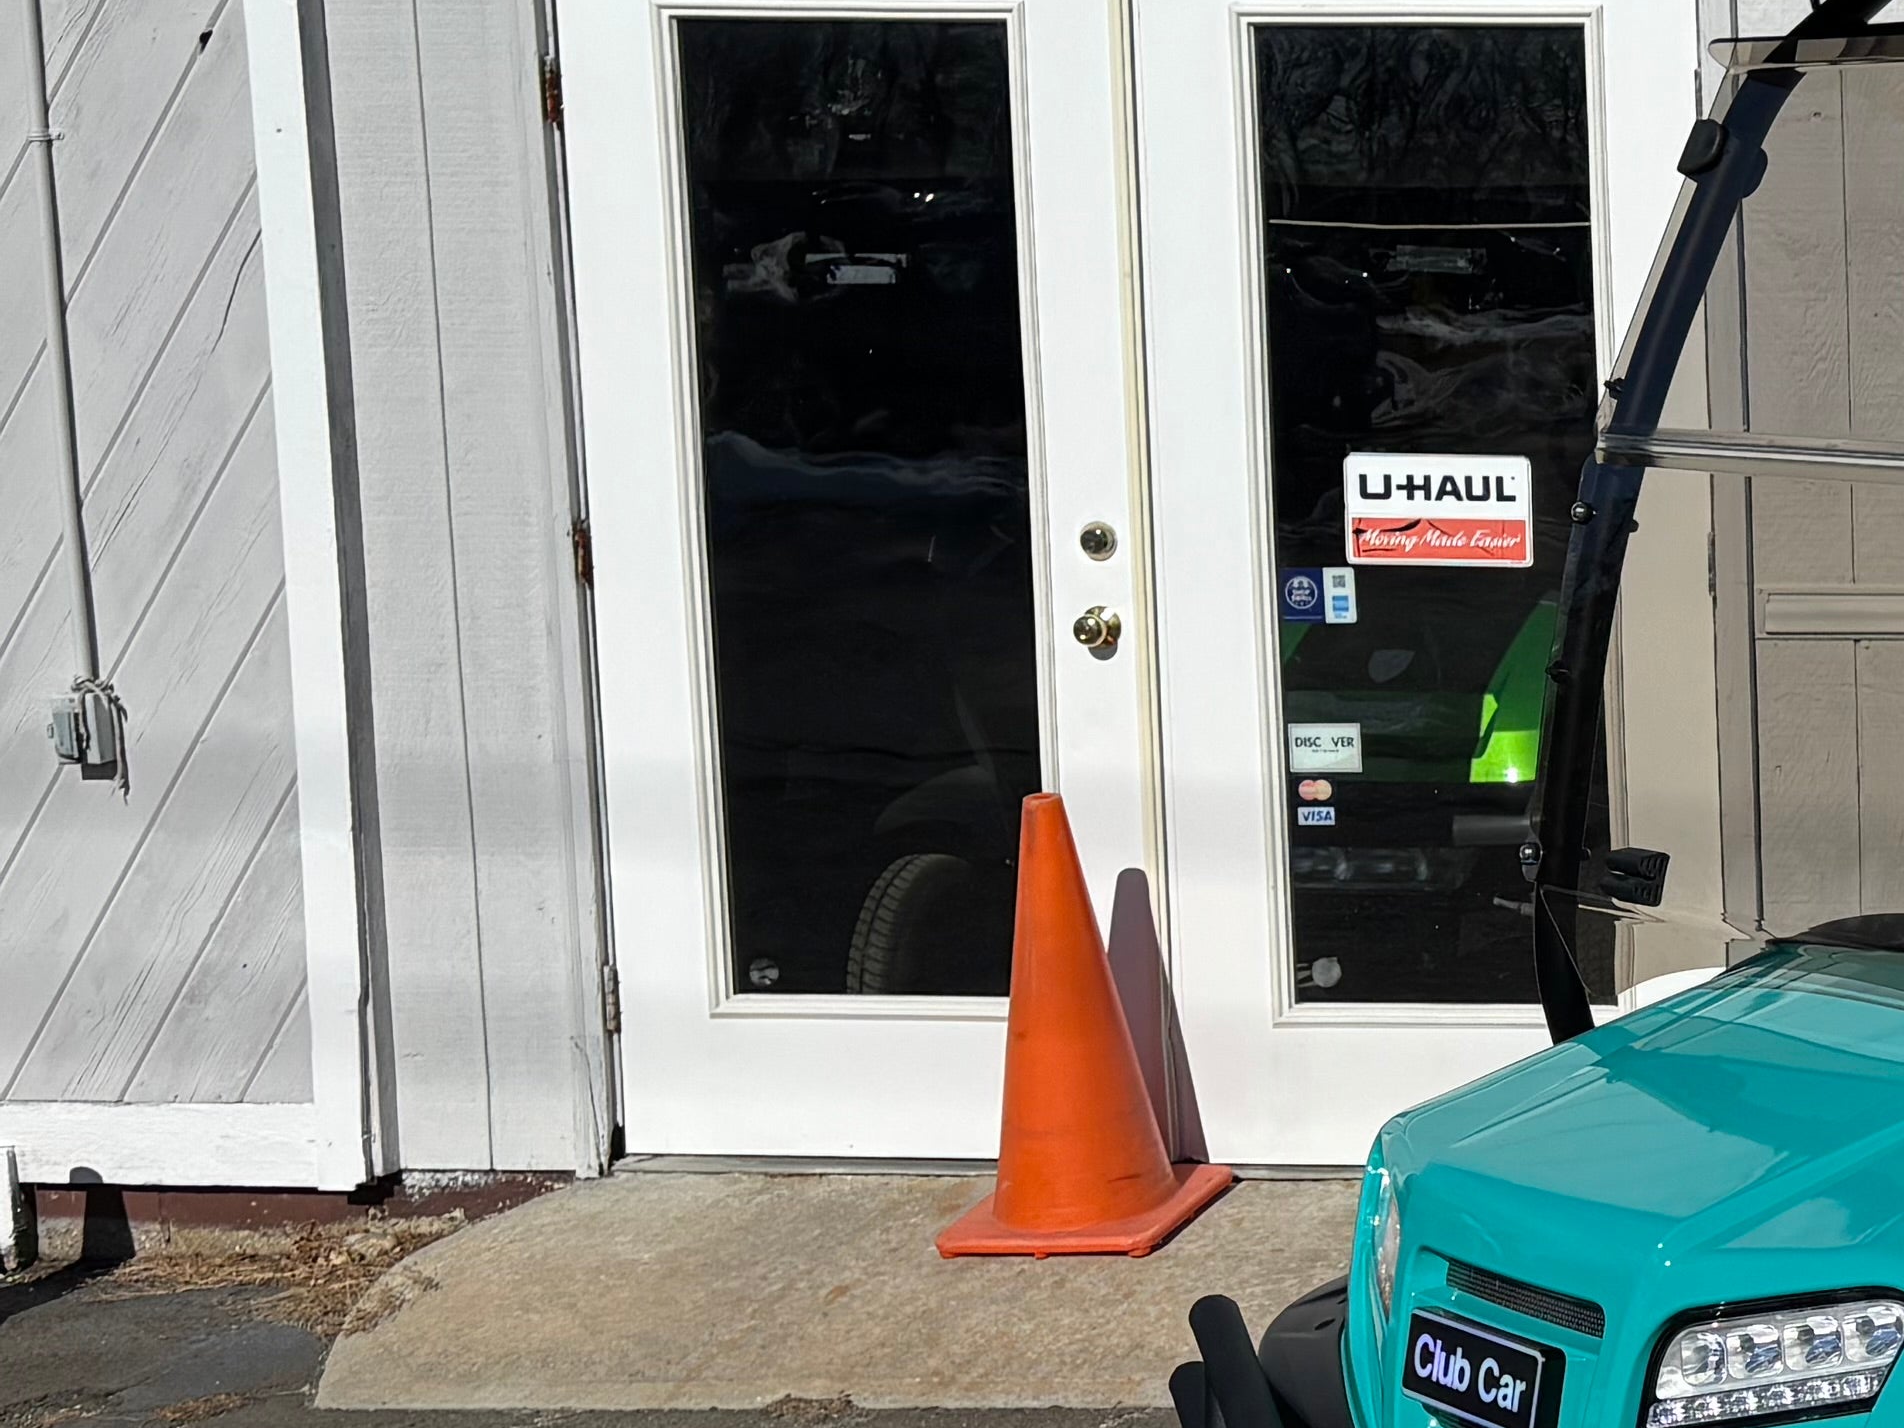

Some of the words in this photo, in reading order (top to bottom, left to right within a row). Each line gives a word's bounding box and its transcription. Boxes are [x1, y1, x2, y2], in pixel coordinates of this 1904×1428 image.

[1358, 473, 1516, 502] U-HAUL
[1360, 528, 1419, 552] Moving
[1420, 529, 1468, 549] Made
[1469, 529, 1521, 549] Easier
[1294, 736, 1355, 749] DISCVER
[1302, 810, 1333, 822] VISA
[1414, 1333, 1471, 1392] Club
[1478, 1357, 1526, 1413] Car
